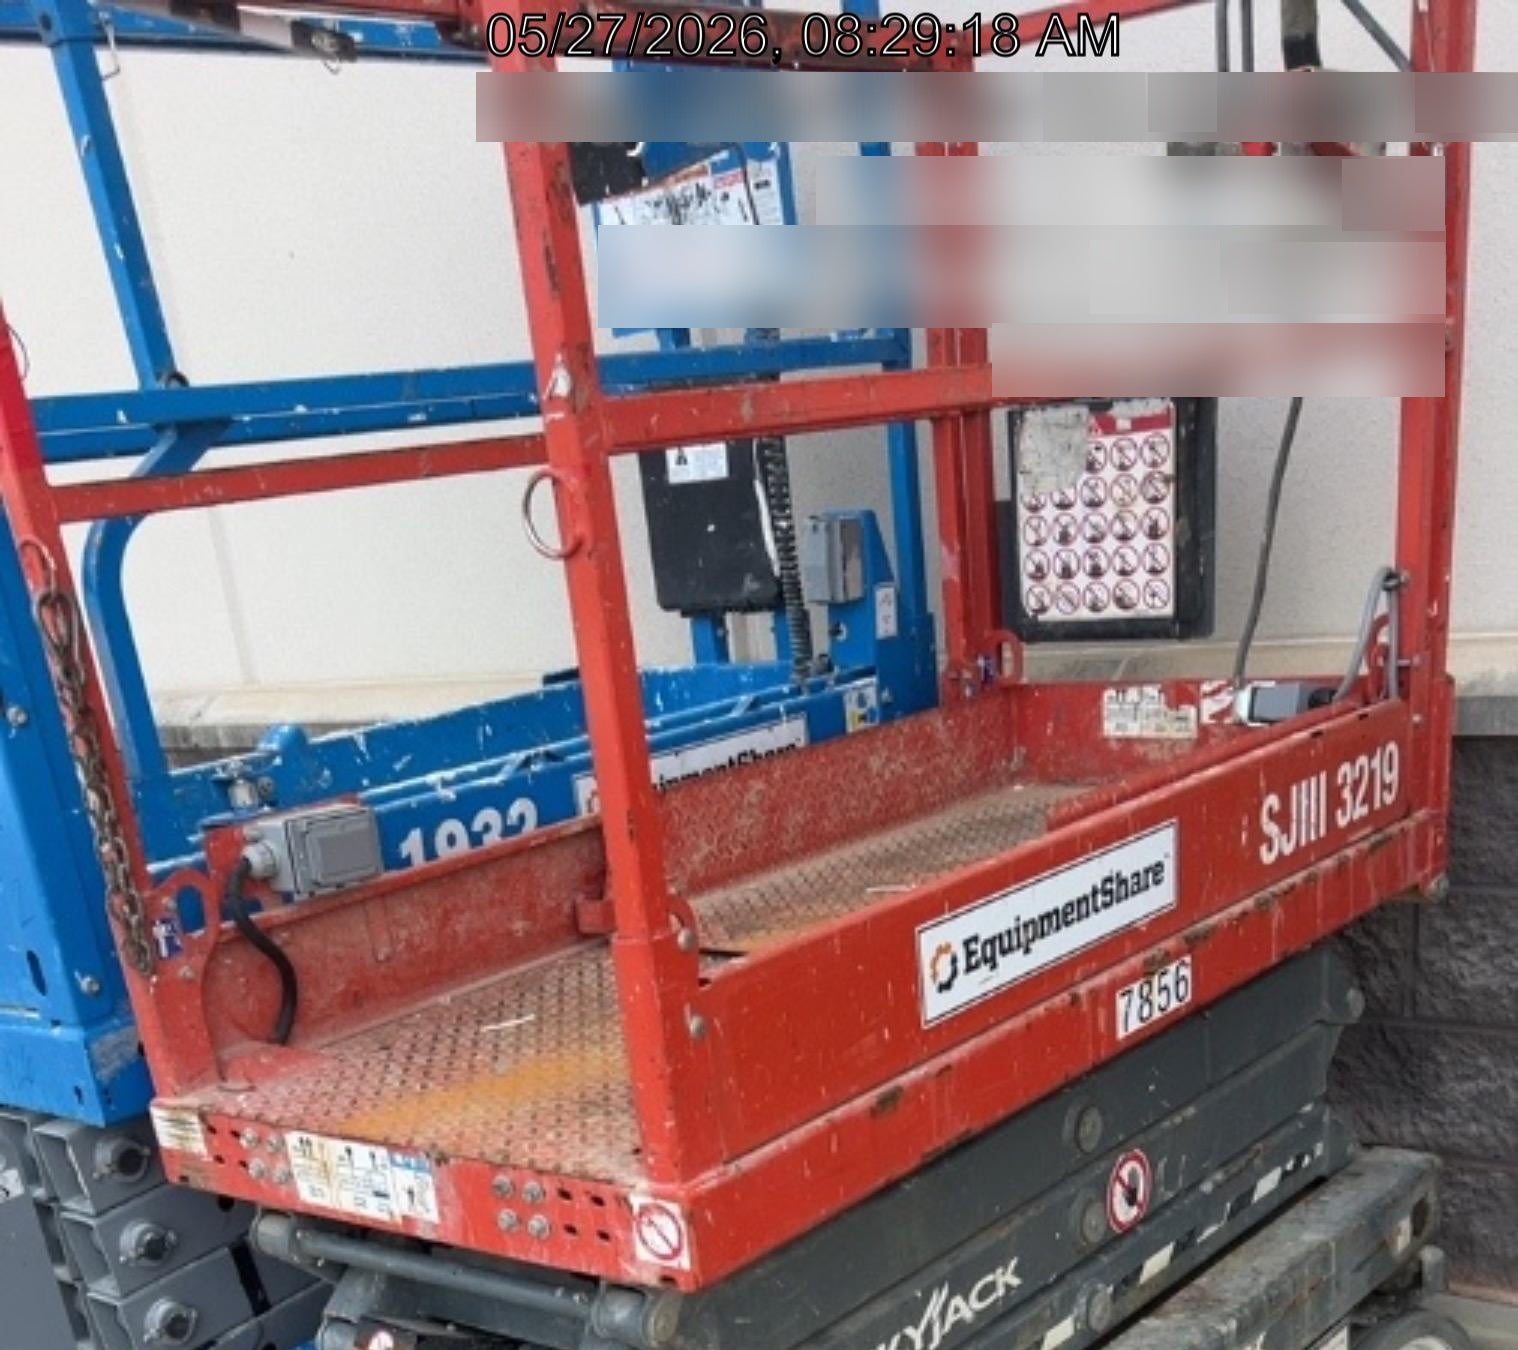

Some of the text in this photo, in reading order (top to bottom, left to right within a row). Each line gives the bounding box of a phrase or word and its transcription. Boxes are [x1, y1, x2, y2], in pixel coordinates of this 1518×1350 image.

[1336, 740, 1400, 829] 3219
[962, 860, 1166, 974] EquipmentShare
[1120, 959, 1189, 1033] 7856
